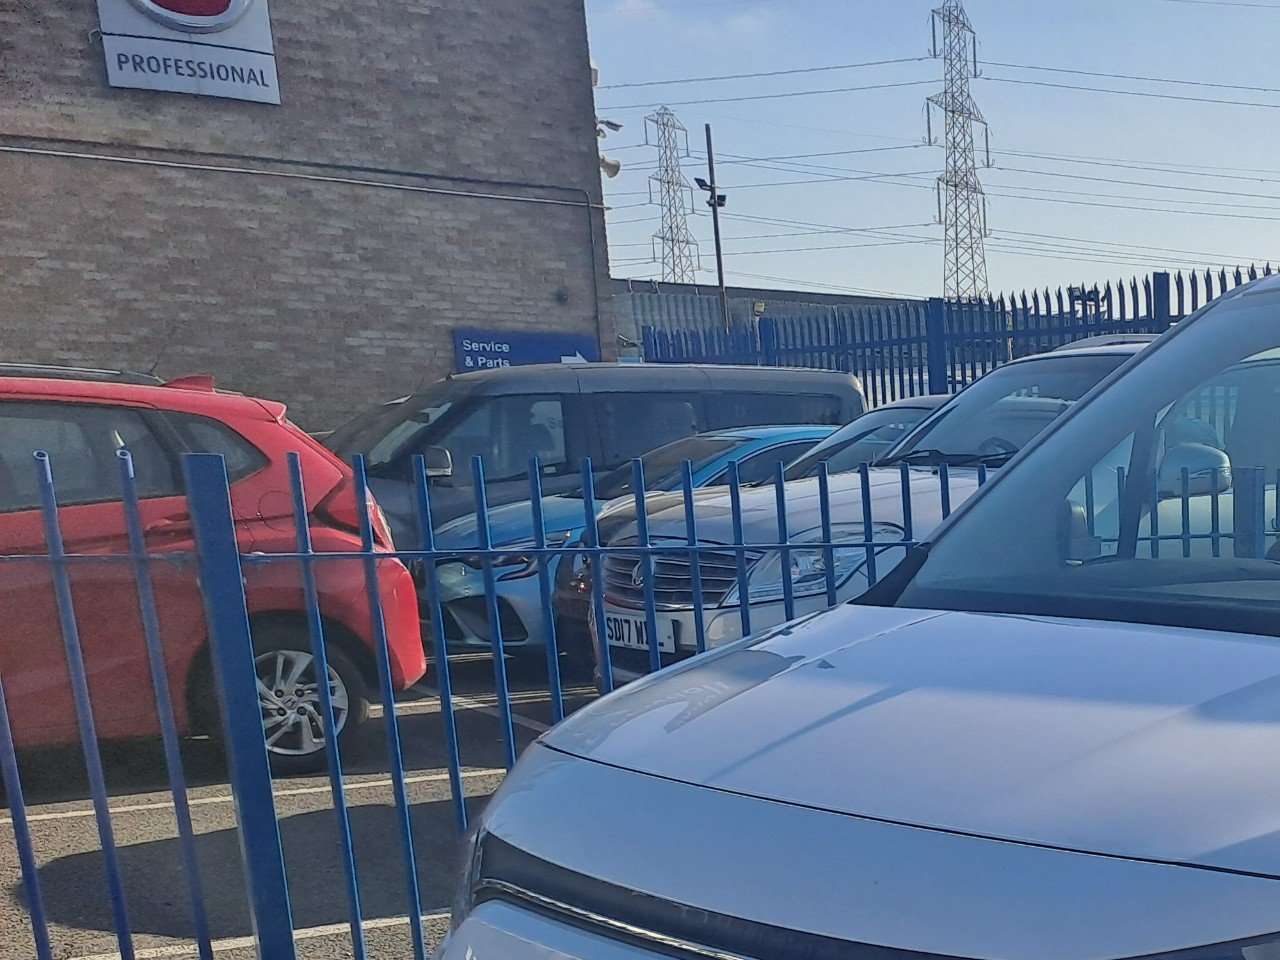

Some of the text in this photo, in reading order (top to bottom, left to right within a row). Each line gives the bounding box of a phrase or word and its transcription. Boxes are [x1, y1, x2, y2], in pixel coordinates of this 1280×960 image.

[116, 53, 270, 88] PROFESSIONAL
[463, 339, 511, 353] Service
[465, 356, 510, 368] & Parts
[606, 617, 631, 644] SD17
